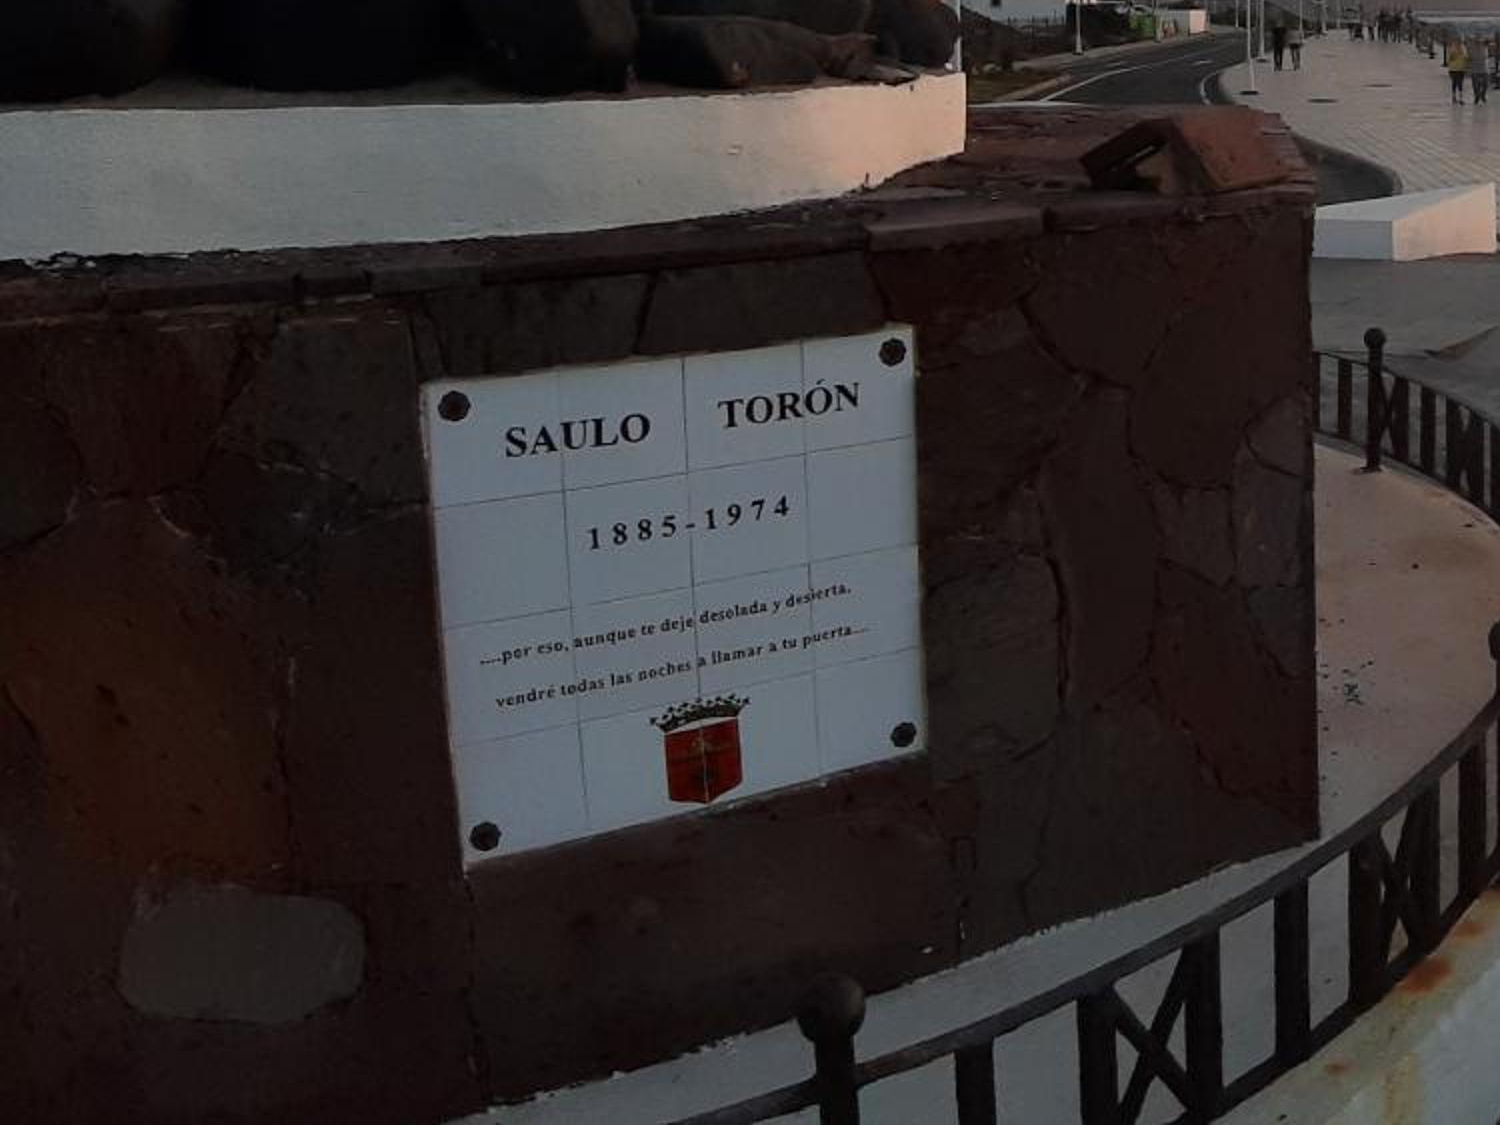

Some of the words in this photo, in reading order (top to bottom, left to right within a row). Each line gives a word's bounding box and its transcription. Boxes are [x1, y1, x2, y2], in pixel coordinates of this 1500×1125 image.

[505, 413, 650, 458] SAULO
[717, 379, 860, 428] TORÓN
[587, 494, 789, 550] 1885-1974
[574, 626, 636, 648] aunque
[641, 624, 656, 636] te
[661, 616, 694, 632] deje
[699, 600, 768, 624] desolada
[773, 599, 781, 614] y
[496, 685, 556, 707] vendré
[561, 678, 605, 696] todas
[611, 674, 633, 687] las
[638, 660, 692, 681] noches
[697, 656, 707, 667] a
[711, 644, 763, 664] llamar
[768, 641, 778, 652] a
[782, 637, 797, 649] tu
